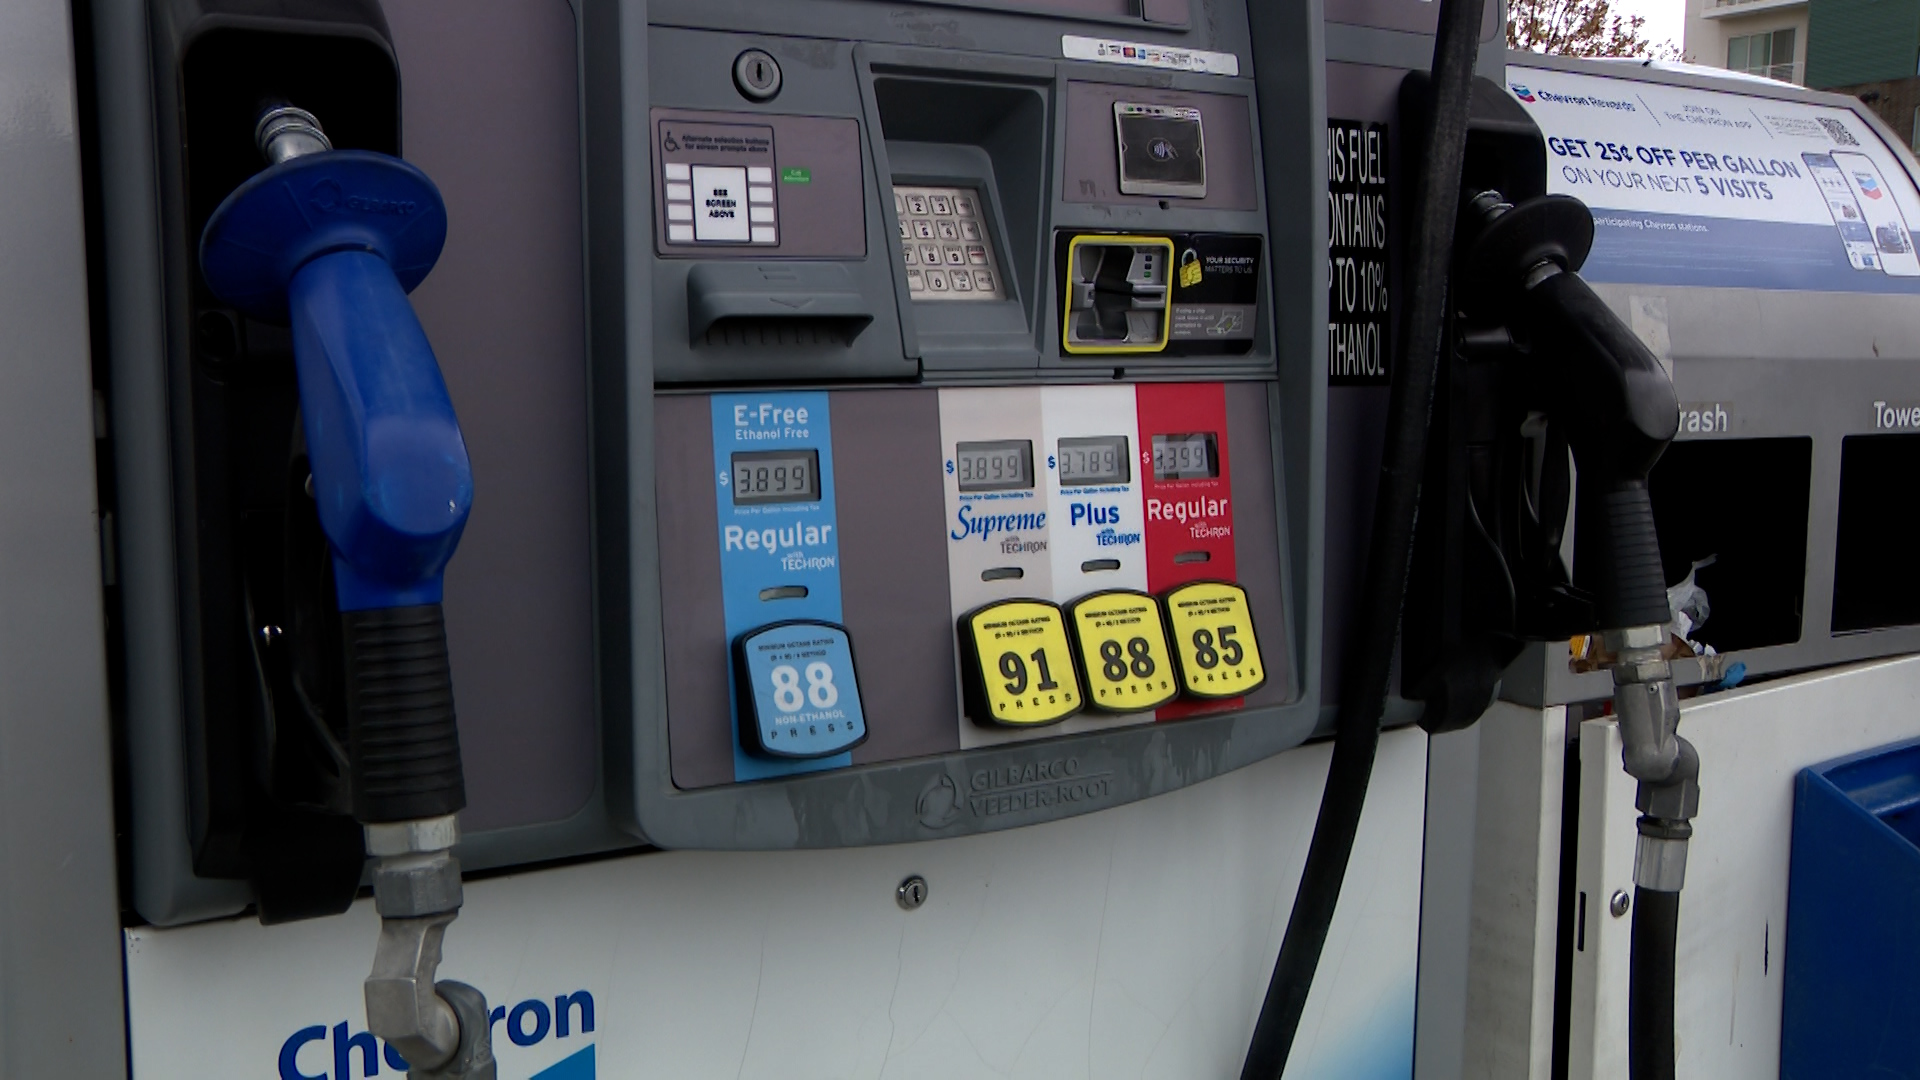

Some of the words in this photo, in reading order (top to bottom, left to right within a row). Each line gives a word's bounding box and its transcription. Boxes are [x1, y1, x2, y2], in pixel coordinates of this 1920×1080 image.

[1350, 129, 1385, 185] FUEL
[1548, 136, 1591, 160] GET
[1594, 141, 1633, 163] 25¢
[1635, 145, 1677, 167] OFF
[1679, 150, 1722, 172] PER
[1722, 154, 1801, 179] GALLON
[1562, 165, 1593, 184] ON
[1593, 169, 1647, 190] YOUR
[1647, 174, 1692, 194] NEXT
[1694, 175, 1709, 195] 5
[1710, 177, 1773, 200] VISITS
[706, 199, 736, 208] SCREEN
[709, 210, 734, 218] ABOVE
[914, 203, 922, 212] 2
[1328, 191, 1386, 249] ONTAINS
[1336, 257, 1357, 313] TO
[1361, 260, 1388, 313] 10%
[1328, 321, 1385, 376] THANOL
[734, 403, 809, 427] E-Free
[1678, 403, 1728, 432] rash
[735, 427, 781, 440] Ethanol
[784, 427, 809, 438] Free
[946, 459, 954, 474] $
[962, 455, 1018, 480] 3.899
[1048, 455, 1056, 469] $
[1062, 451, 1114, 475] 3.789
[1143, 451, 1150, 464] $
[719, 470, 729, 486] $
[740, 465, 804, 494] 3.899
[951, 504, 1046, 542] Supreme
[1070, 502, 1120, 527] Plus
[1147, 495, 1228, 524] Regular
[724, 521, 832, 555] Regular
[1096, 533, 1140, 545] TECHRON
[1189, 526, 1231, 539] TECHRON
[1000, 541, 1047, 554] TECHRON
[781, 556, 835, 571] TECHRON
[1100, 637, 1155, 682] 88
[1192, 625, 1243, 669] 85
[998, 647, 1058, 695] 91
[1193, 668, 1256, 683] PRESS
[771, 661, 838, 713] 88
[1100, 681, 1167, 697] PRESS
[999, 693, 1071, 711] PRESS
[771, 721, 854, 739] PRESS
[775, 709, 846, 725] NON-ETHANOL
[970, 758, 1078, 791] GILBARCO
[969, 779, 1114, 817] VEEDER-ROOT
[278, 989, 595, 1080] Chron
